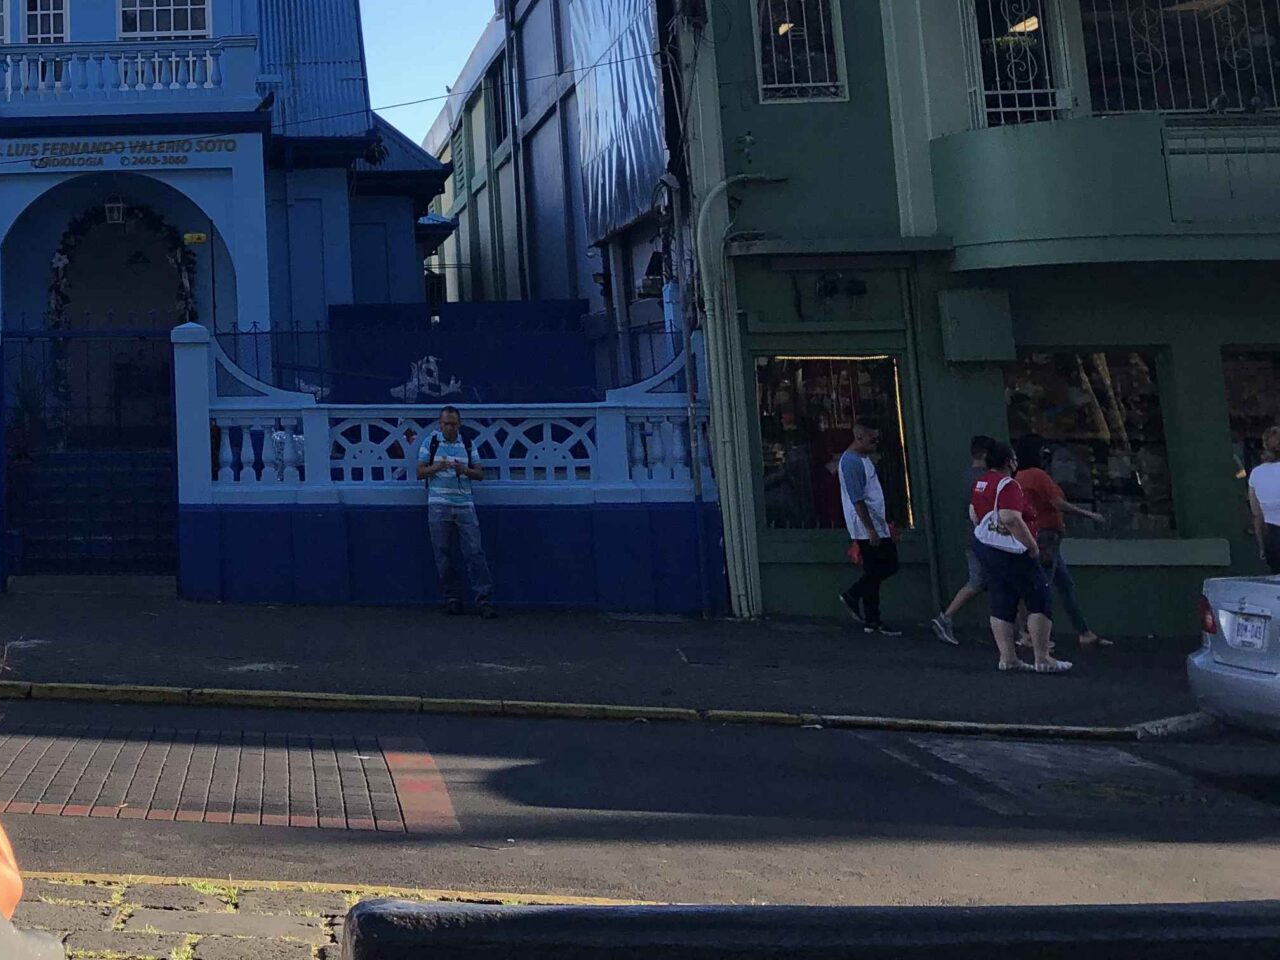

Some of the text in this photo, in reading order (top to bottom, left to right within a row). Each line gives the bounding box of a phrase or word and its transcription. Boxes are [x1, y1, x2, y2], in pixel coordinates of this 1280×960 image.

[7, 142, 39, 157] LUIS
[41, 141, 125, 156] FERNANDO
[195, 139, 237, 152] SOTO
